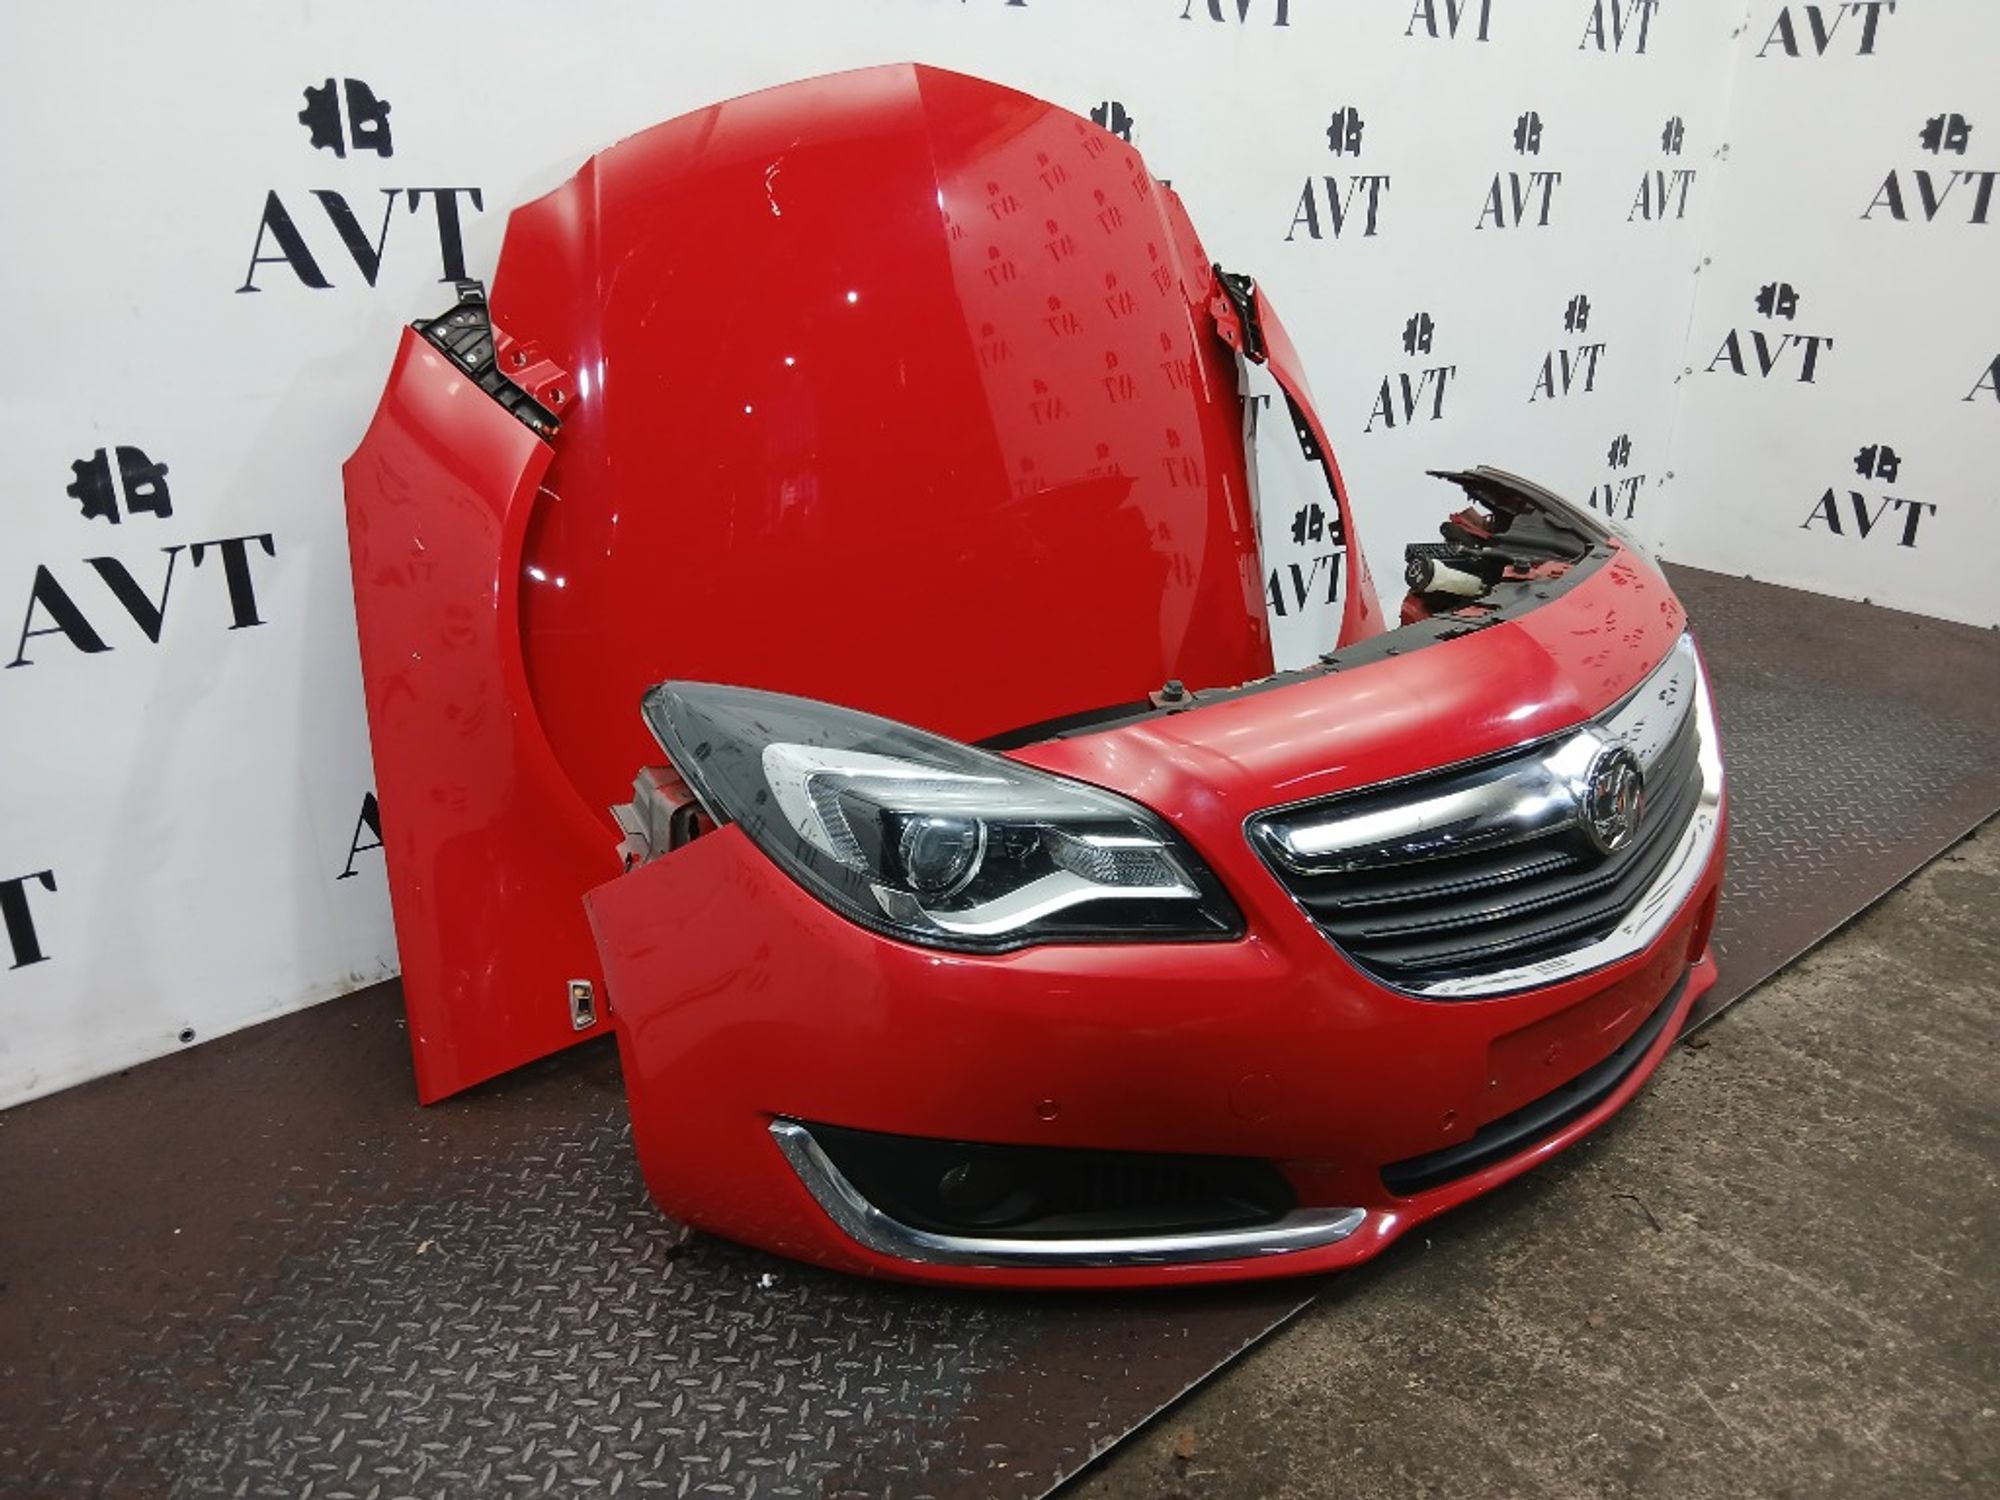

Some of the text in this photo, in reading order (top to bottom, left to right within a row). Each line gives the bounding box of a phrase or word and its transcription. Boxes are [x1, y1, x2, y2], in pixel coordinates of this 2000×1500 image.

[1579, 0, 1659, 54] AVT
[1756, 0, 1897, 58] AVT
[1284, 176, 1390, 241] AVT
[1475, 172, 1562, 229] AVT
[1627, 170, 1696, 222] AVT
[1860, 169, 2000, 224] AVT
[235, 187, 484, 293] AVT
[1528, 343, 1606, 403] AVT
[1704, 328, 1833, 384] AVT
[1364, 365, 1456, 433] AVT
[1799, 487, 1937, 548] AVT
[5, 533, 276, 669] AVT
